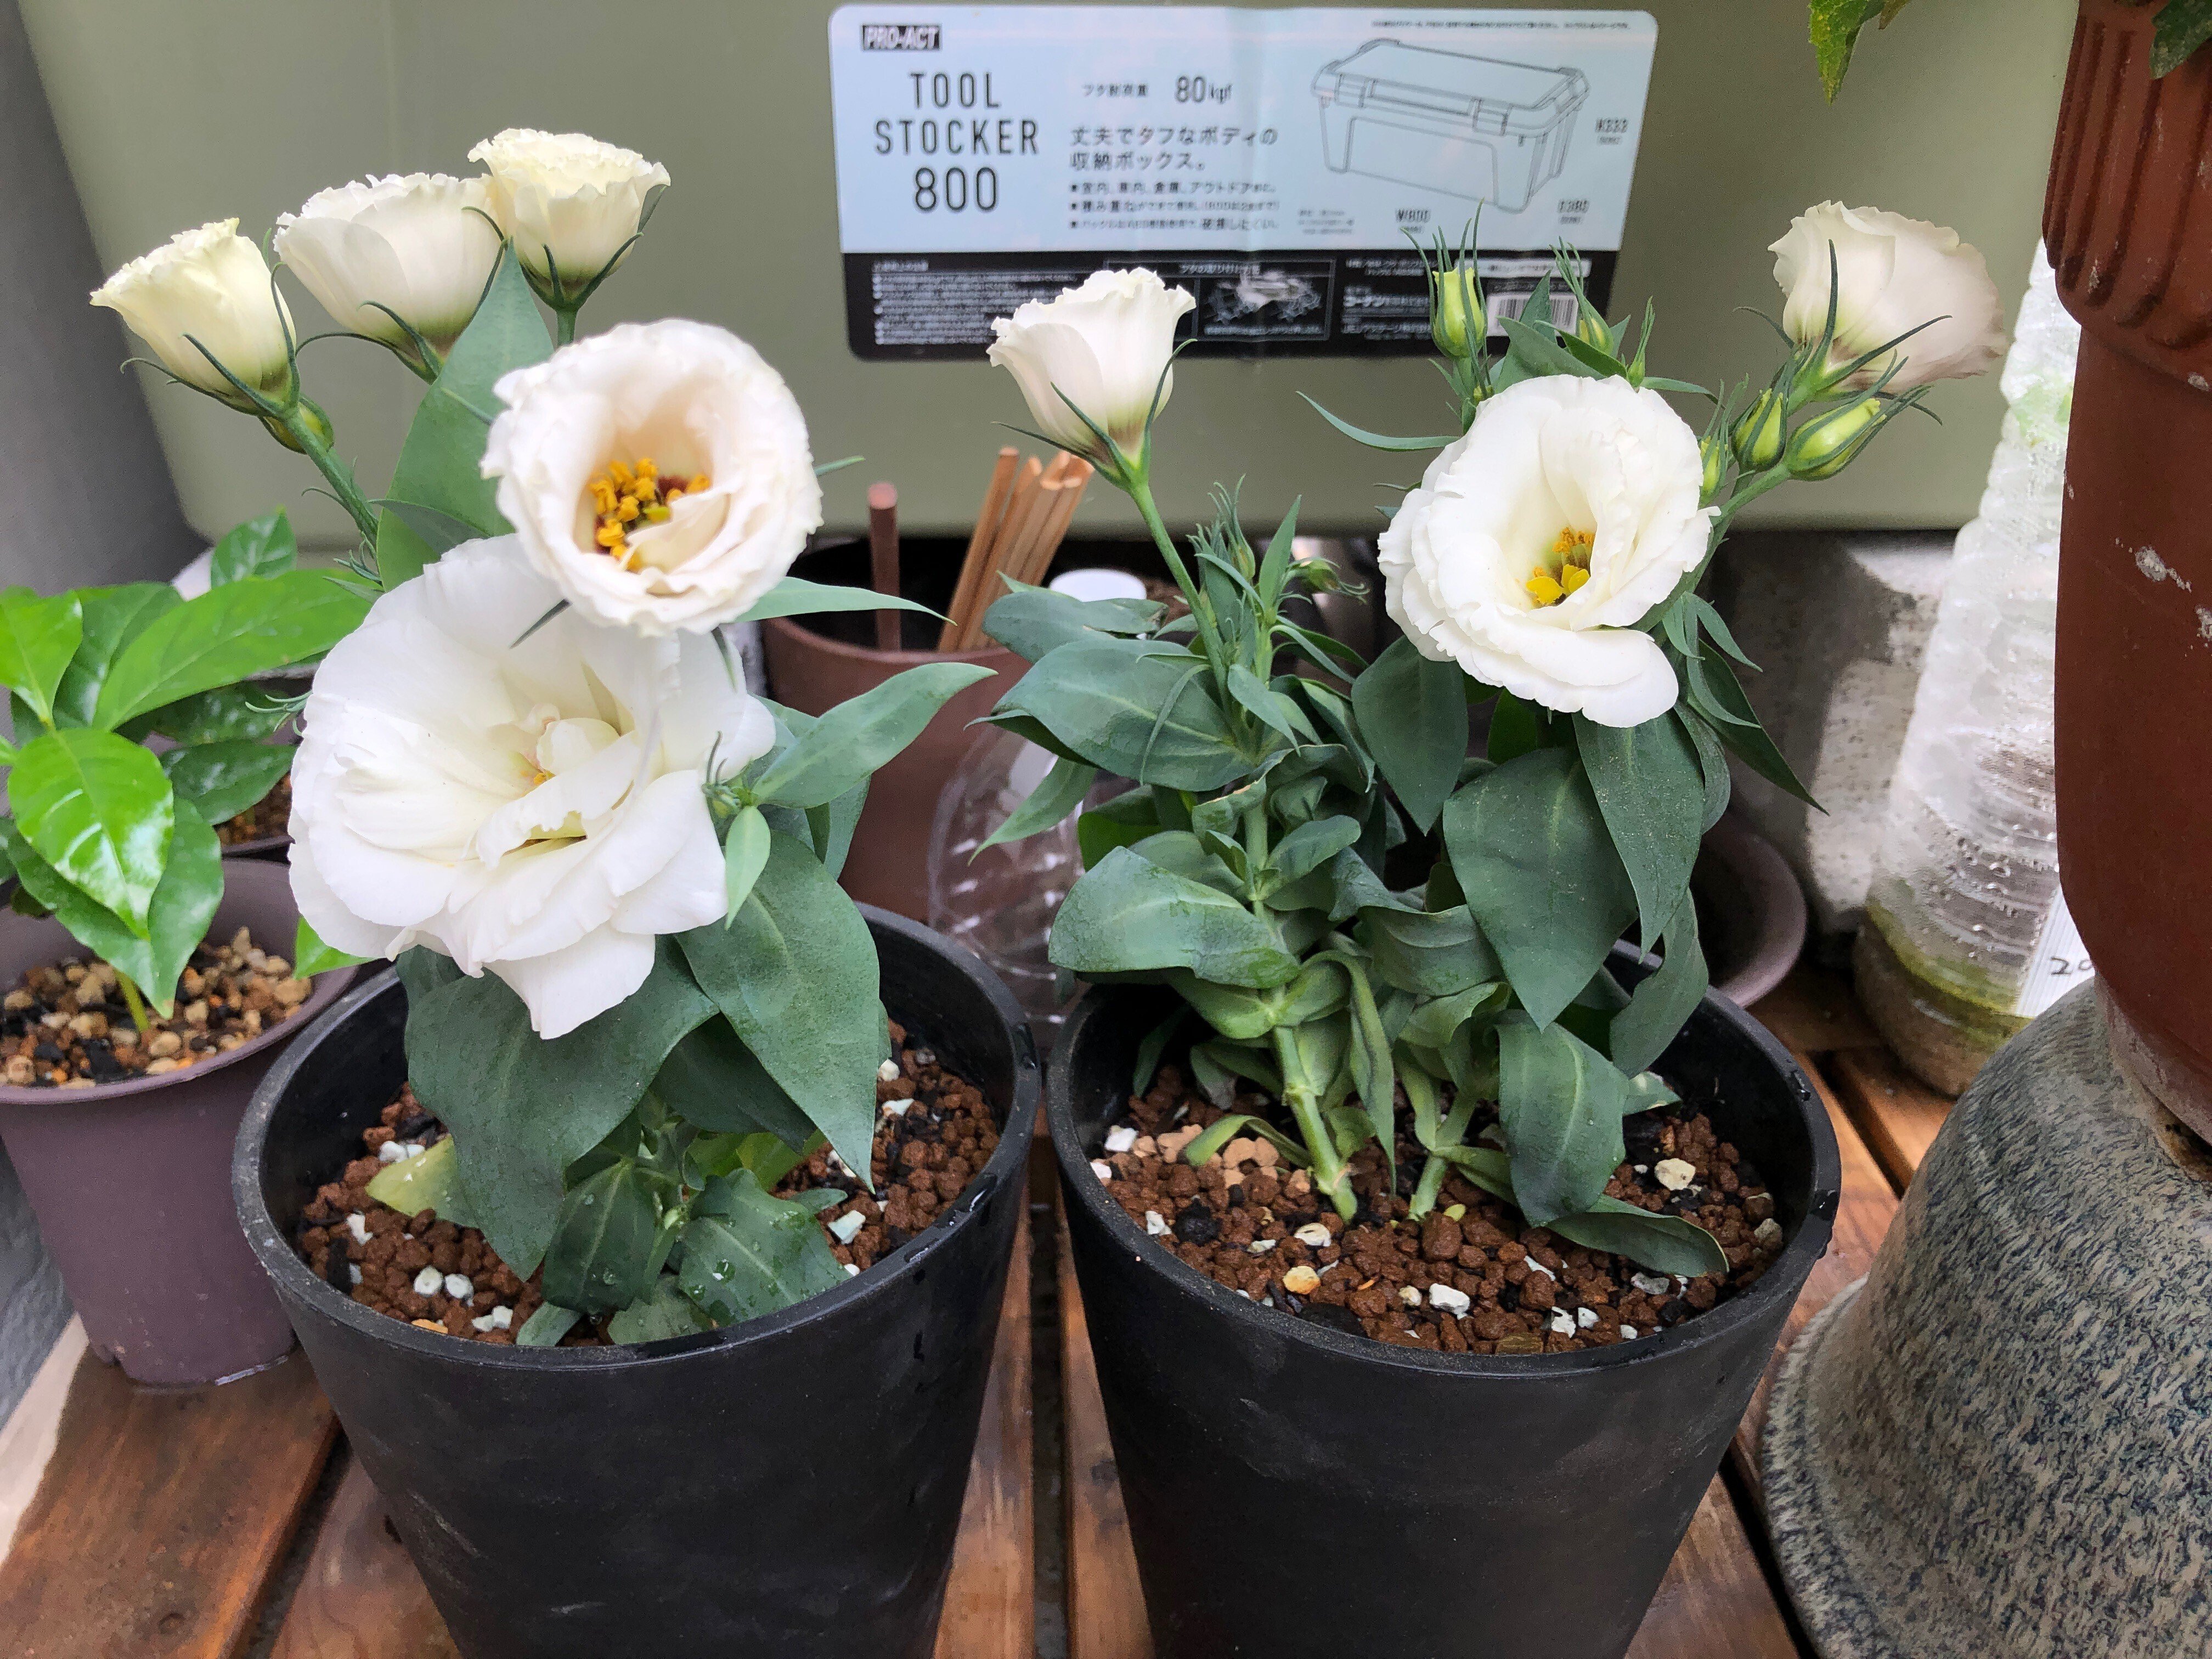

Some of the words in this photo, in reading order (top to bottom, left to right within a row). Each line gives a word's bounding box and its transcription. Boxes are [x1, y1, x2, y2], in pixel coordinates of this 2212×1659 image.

[864, 27, 939, 49] PRO-ACT
[909, 71, 1001, 109] TOOL
[874, 119, 1039, 156] STOCKER
[912, 166, 999, 213] 800
